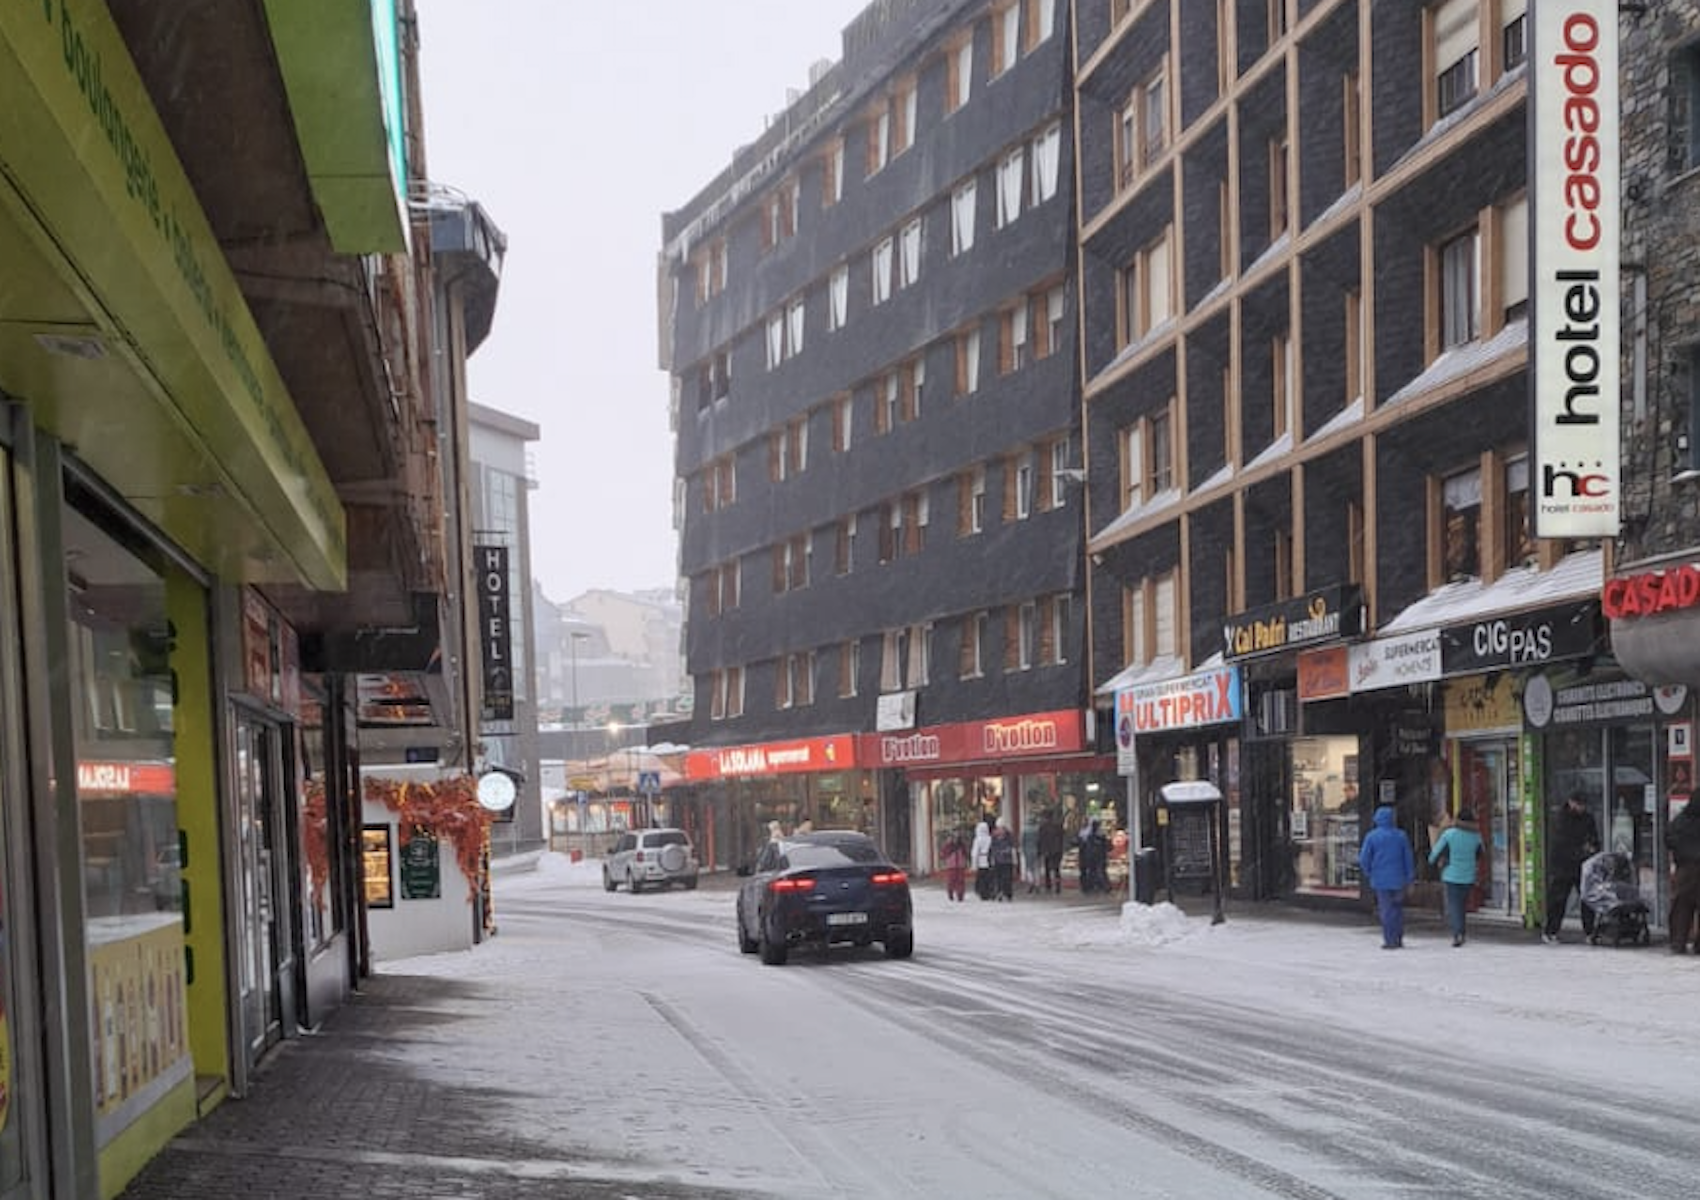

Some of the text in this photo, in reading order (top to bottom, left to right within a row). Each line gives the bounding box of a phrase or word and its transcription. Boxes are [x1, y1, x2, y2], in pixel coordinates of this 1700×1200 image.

[1554, 11, 1600, 426] hotel casado
[1541, 504, 1614, 514] hotel casado
[485, 549, 503, 661] HOTEL
[1603, 566, 1700, 620] CASAD
[1234, 622, 1253, 654] Cal
[1473, 620, 1553, 663] CIG PAS
[881, 732, 940, 762] D'votion
[984, 719, 1056, 752] D'votion
